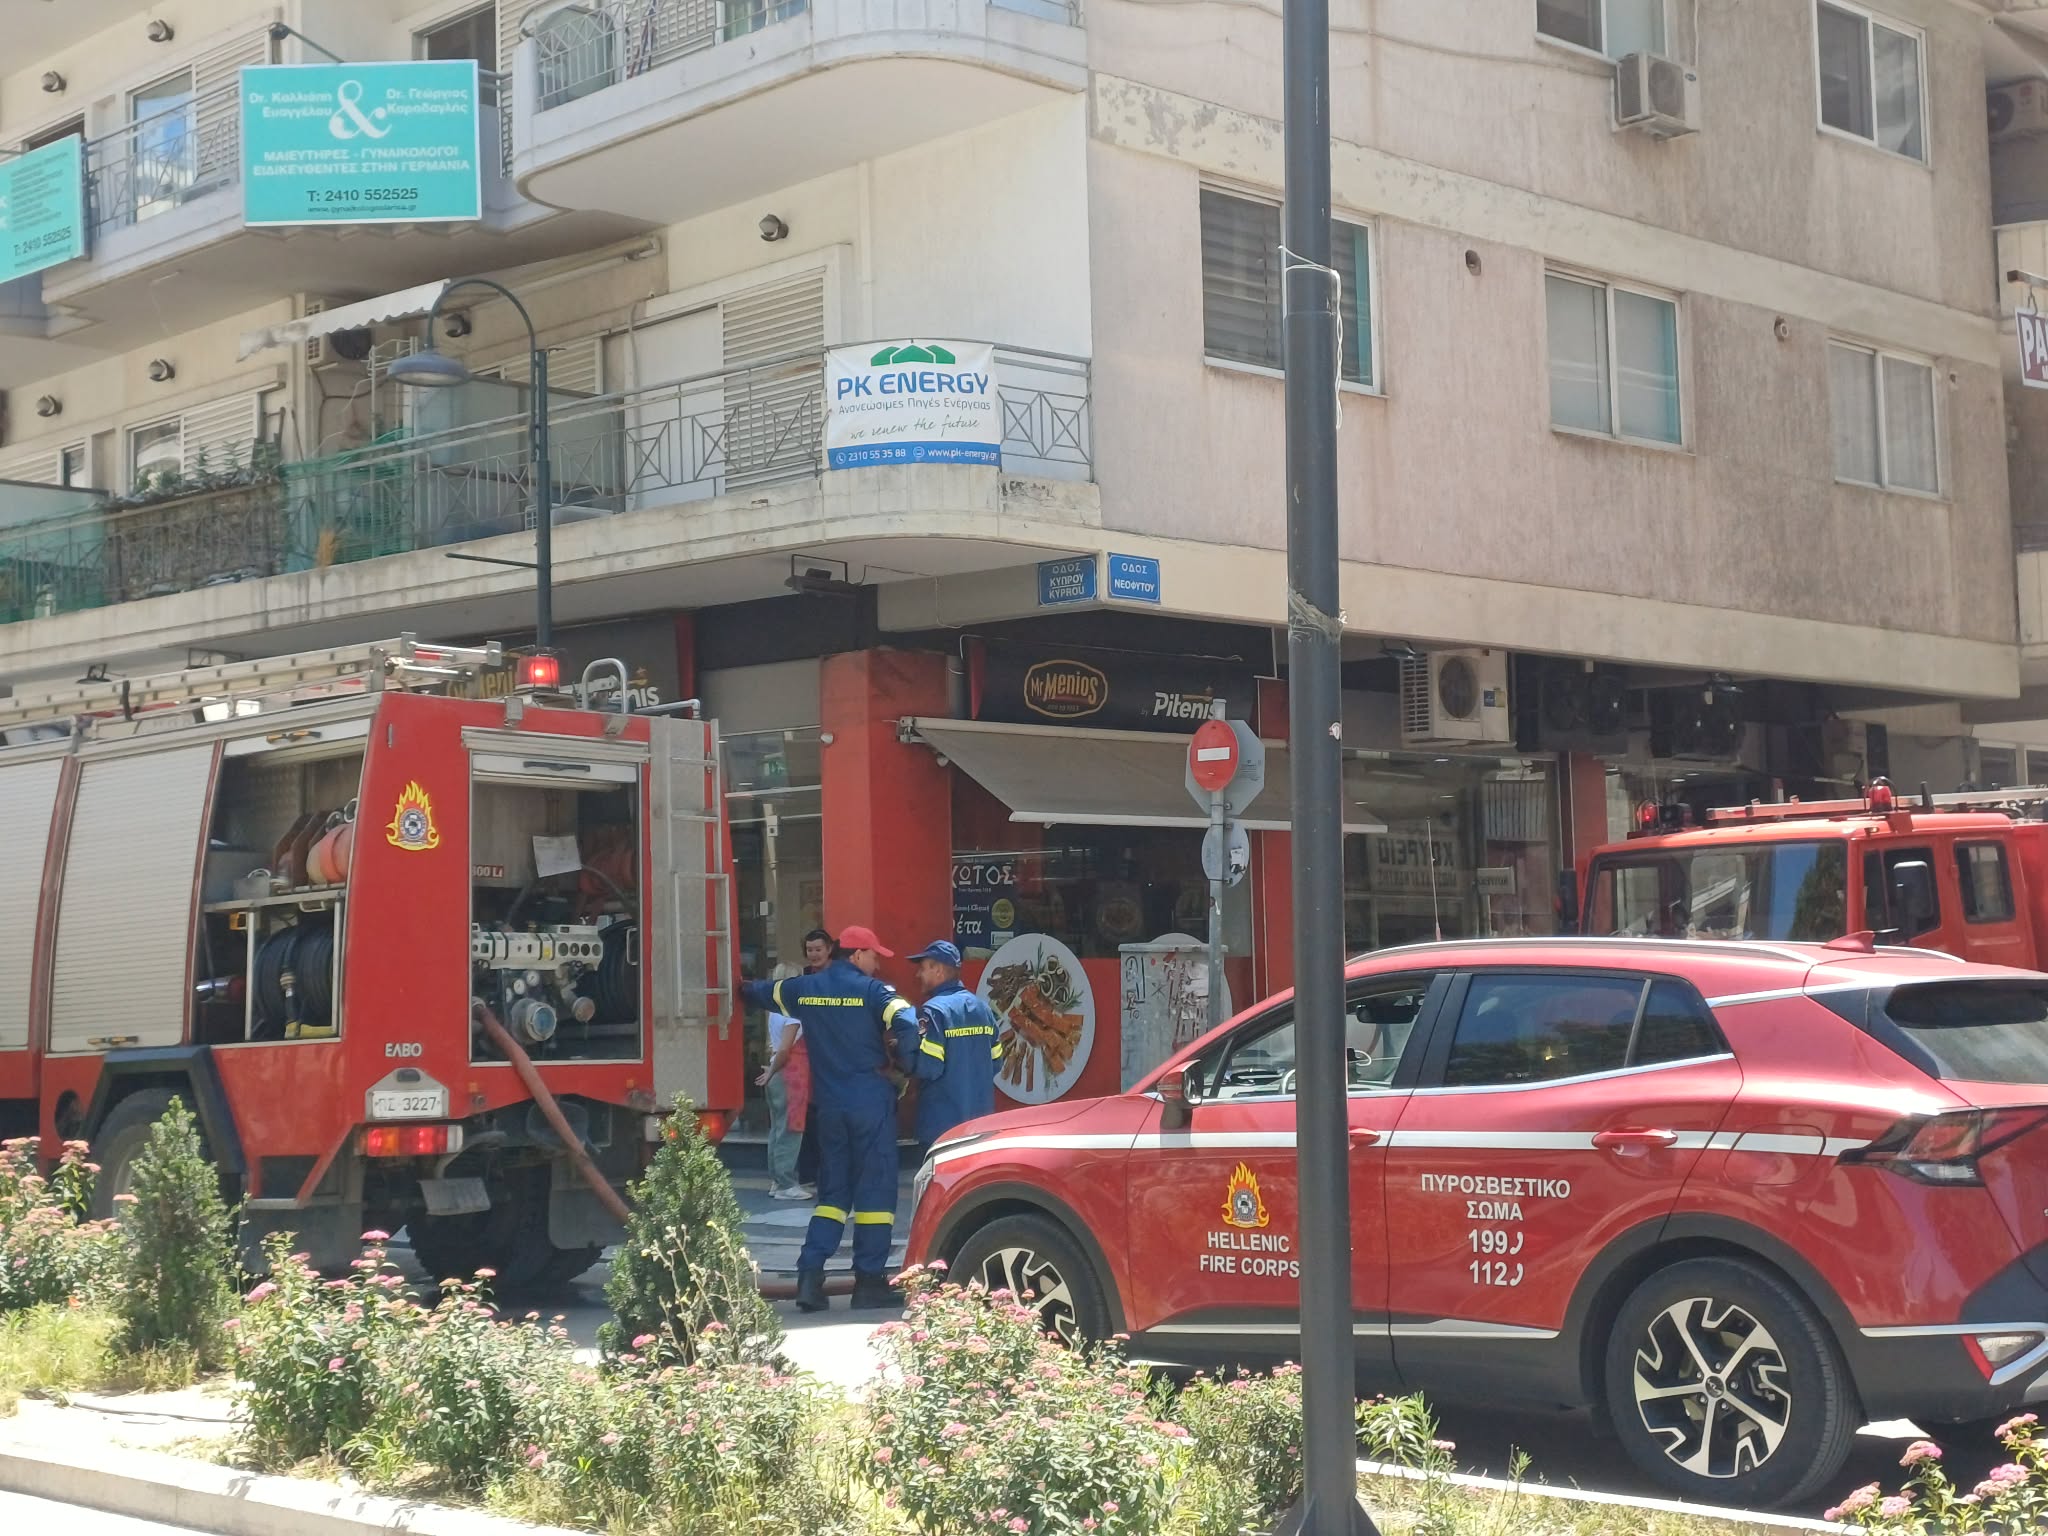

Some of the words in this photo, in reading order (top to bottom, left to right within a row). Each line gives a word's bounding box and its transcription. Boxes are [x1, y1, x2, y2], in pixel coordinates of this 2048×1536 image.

[263, 149, 350, 162] ΜΑΙΕΥΤΗΡΕΣ
[360, 146, 459, 159] ΓΥΝΑΙΚΟΛΟΓΟΙ
[252, 163, 359, 176] ΕΙΔΙΚΕΥΘΕΝΤΕΣ
[360, 161, 398, 173] ΣΤΗΝ
[401, 160, 470, 172] ΓΕΡΜΑΝΙΑ
[306, 190, 321, 202] T:
[325, 189, 360, 201] 2410
[364, 188, 418, 200] 552525
[2020, 317, 2048, 372] PA
[837, 375, 872, 401] PK
[879, 371, 989, 395] ENERGY
[907, 397, 941, 410] Πηγές
[944, 397, 991, 413] Ενέργειας
[849, 430, 865, 441] we
[871, 425, 908, 437] renew
[914, 417, 937, 431] the
[941, 414, 980, 439] future
[848, 451, 868, 462] 2310
[869, 450, 881, 460] 55
[881, 449, 894, 459] 35
[895, 448, 906, 458] 88
[928, 447, 998, 462] www.pk-energy.gr
[1052, 563, 1081, 575] ΟΔΟΣ
[1121, 562, 1148, 574] ΟΔΟΣ
[1049, 573, 1084, 587] ΚΥΠΡΟΥ
[1114, 579, 1155, 593] ΝΕΟΦΥΤΟΥ
[1049, 586, 1085, 599] KYPROU
[1031, 677, 1044, 698] Mr
[1043, 670, 1098, 705] Menios
[952, 913, 983, 934] έτα
[385, 1042, 422, 1057] ΕΛΒΟ
[402, 1096, 437, 1111] 3227
[1420, 1174, 1571, 1199] ΠΥΡΟΣΒΕΣΤΙΚΟ
[1466, 1200, 1524, 1222] ΣΩΜΑ
[1207, 1231, 1290, 1253] HELLENIC
[1468, 1229, 1509, 1254] 199
[1200, 1254, 1236, 1274] FIRE
[1240, 1257, 1300, 1279] CORPS
[1469, 1261, 1508, 1287] 112
